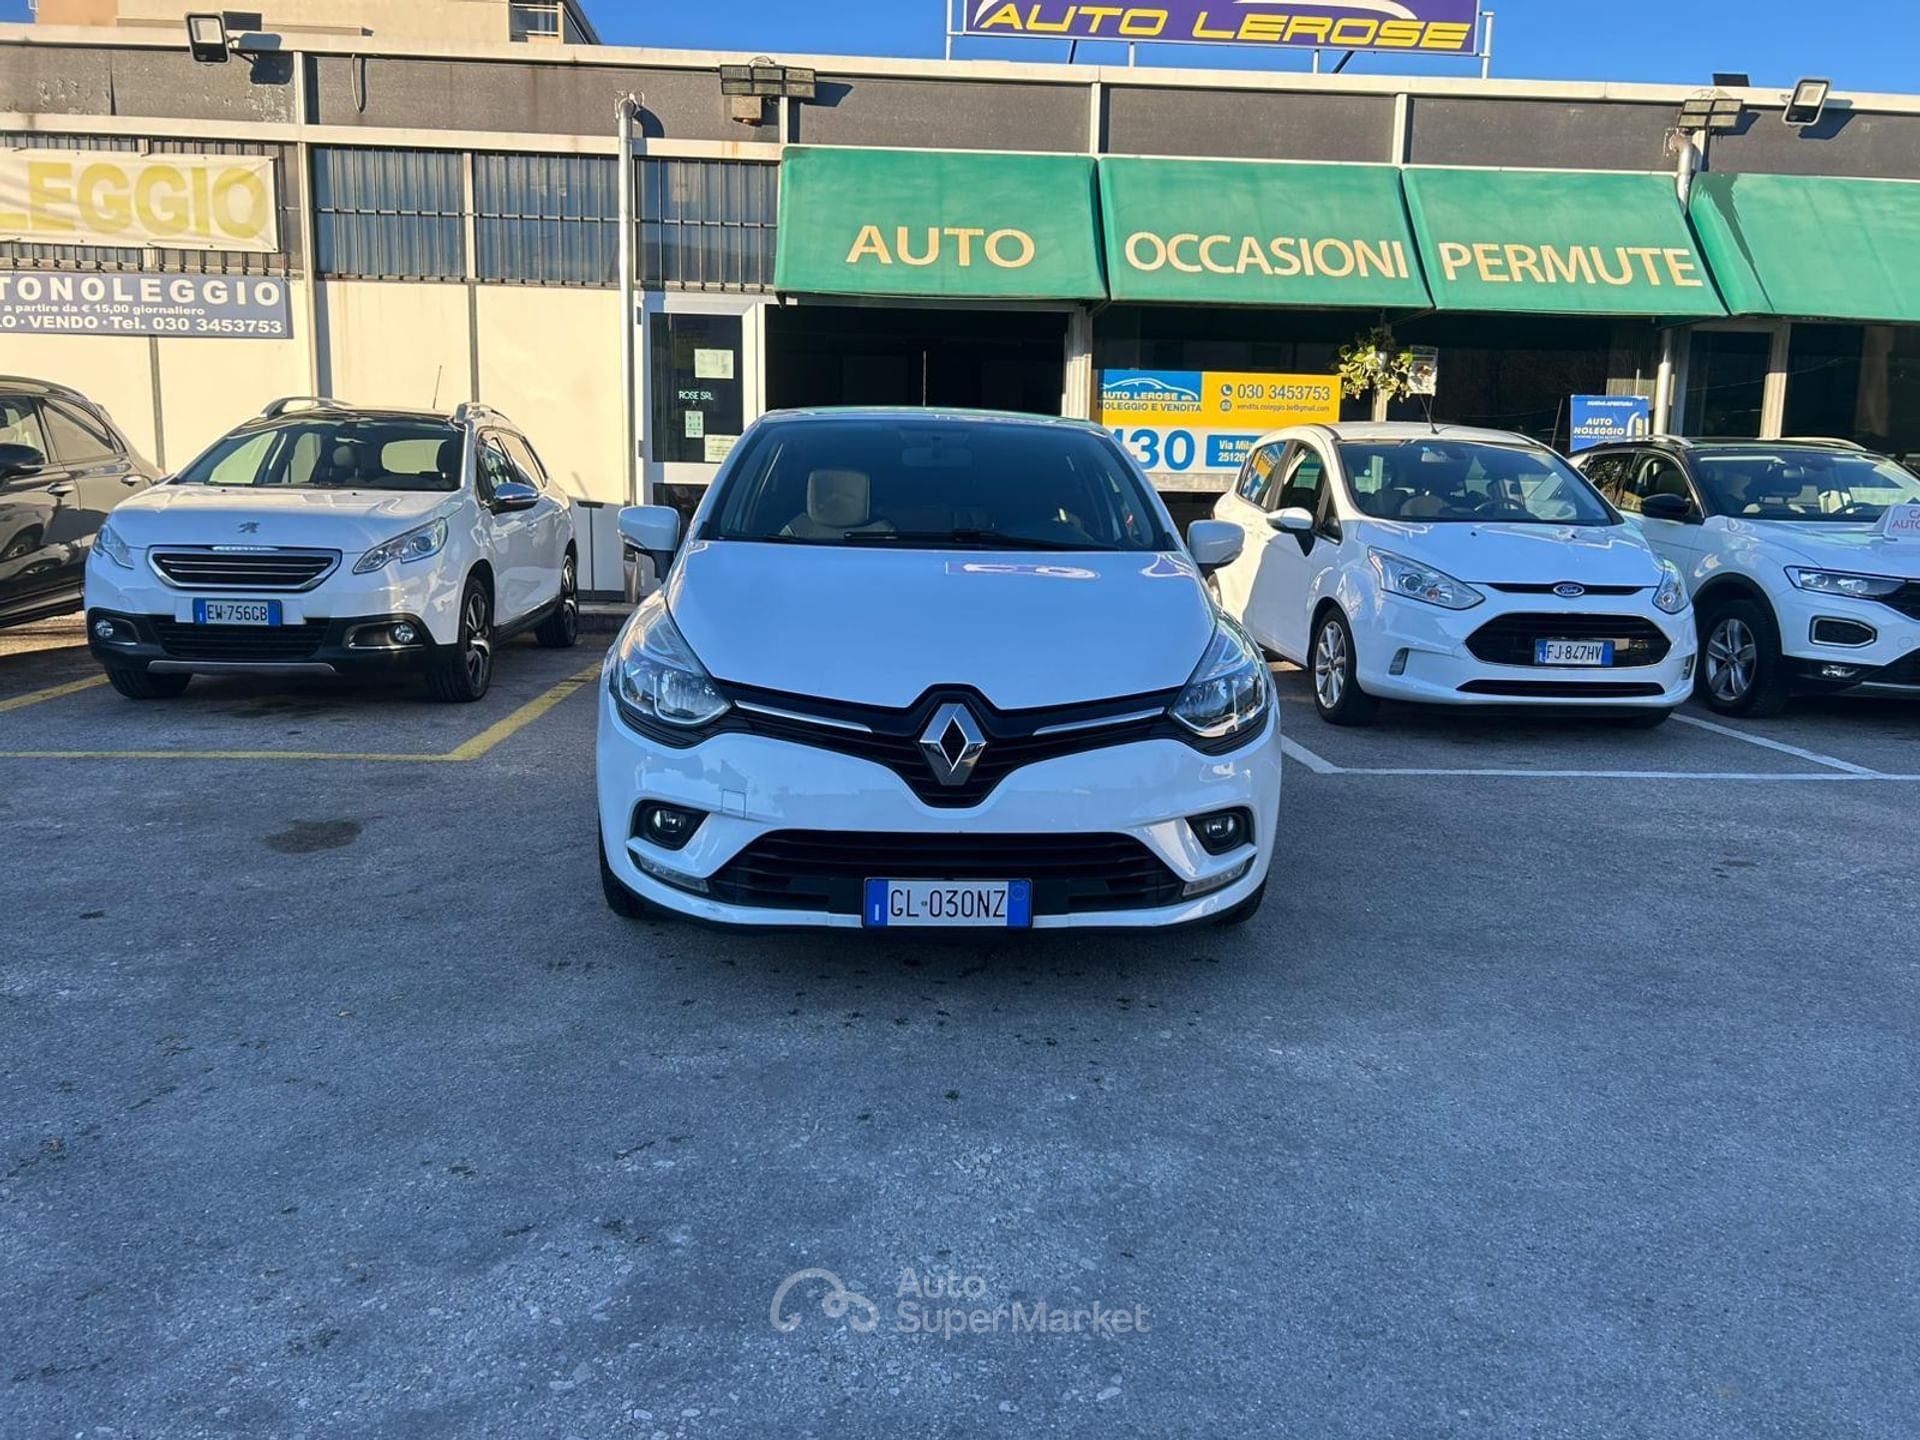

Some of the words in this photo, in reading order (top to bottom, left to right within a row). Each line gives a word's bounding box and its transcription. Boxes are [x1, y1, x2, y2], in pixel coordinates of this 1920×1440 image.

[979, 3, 1169, 36] AUTO
[1192, 11, 1471, 49] LEROSE
[845, 225, 1036, 268] AUTO
[1125, 231, 1409, 278] OCCASIONI
[1438, 242, 1703, 287] PERMUTE
[15, 303, 59, 314] partire
[62, 303, 78, 312] da
[94, 304, 129, 314] 15,00
[133, 305, 205, 316] giornaliero
[0, 315, 16, 328] O
[28, 315, 98, 329] VENDO
[110, 317, 146, 329] Tel.
[152, 317, 190, 330] 030
[196, 318, 282, 334] 3453753
[1102, 391, 1130, 400] AUTO
[1134, 392, 1178, 401] LEROSE
[1237, 384, 1264, 399] 030
[1268, 385, 1330, 401] 3453753
[1097, 402, 1149, 411] NOLEGGIO
[1151, 403, 1158, 411] E
[1160, 403, 1202, 412] VENDITA
[1585, 417, 1613, 426] AUTO
[1574, 427, 1625, 436] NOLEGGIO
[1219, 439, 1233, 450] Via
